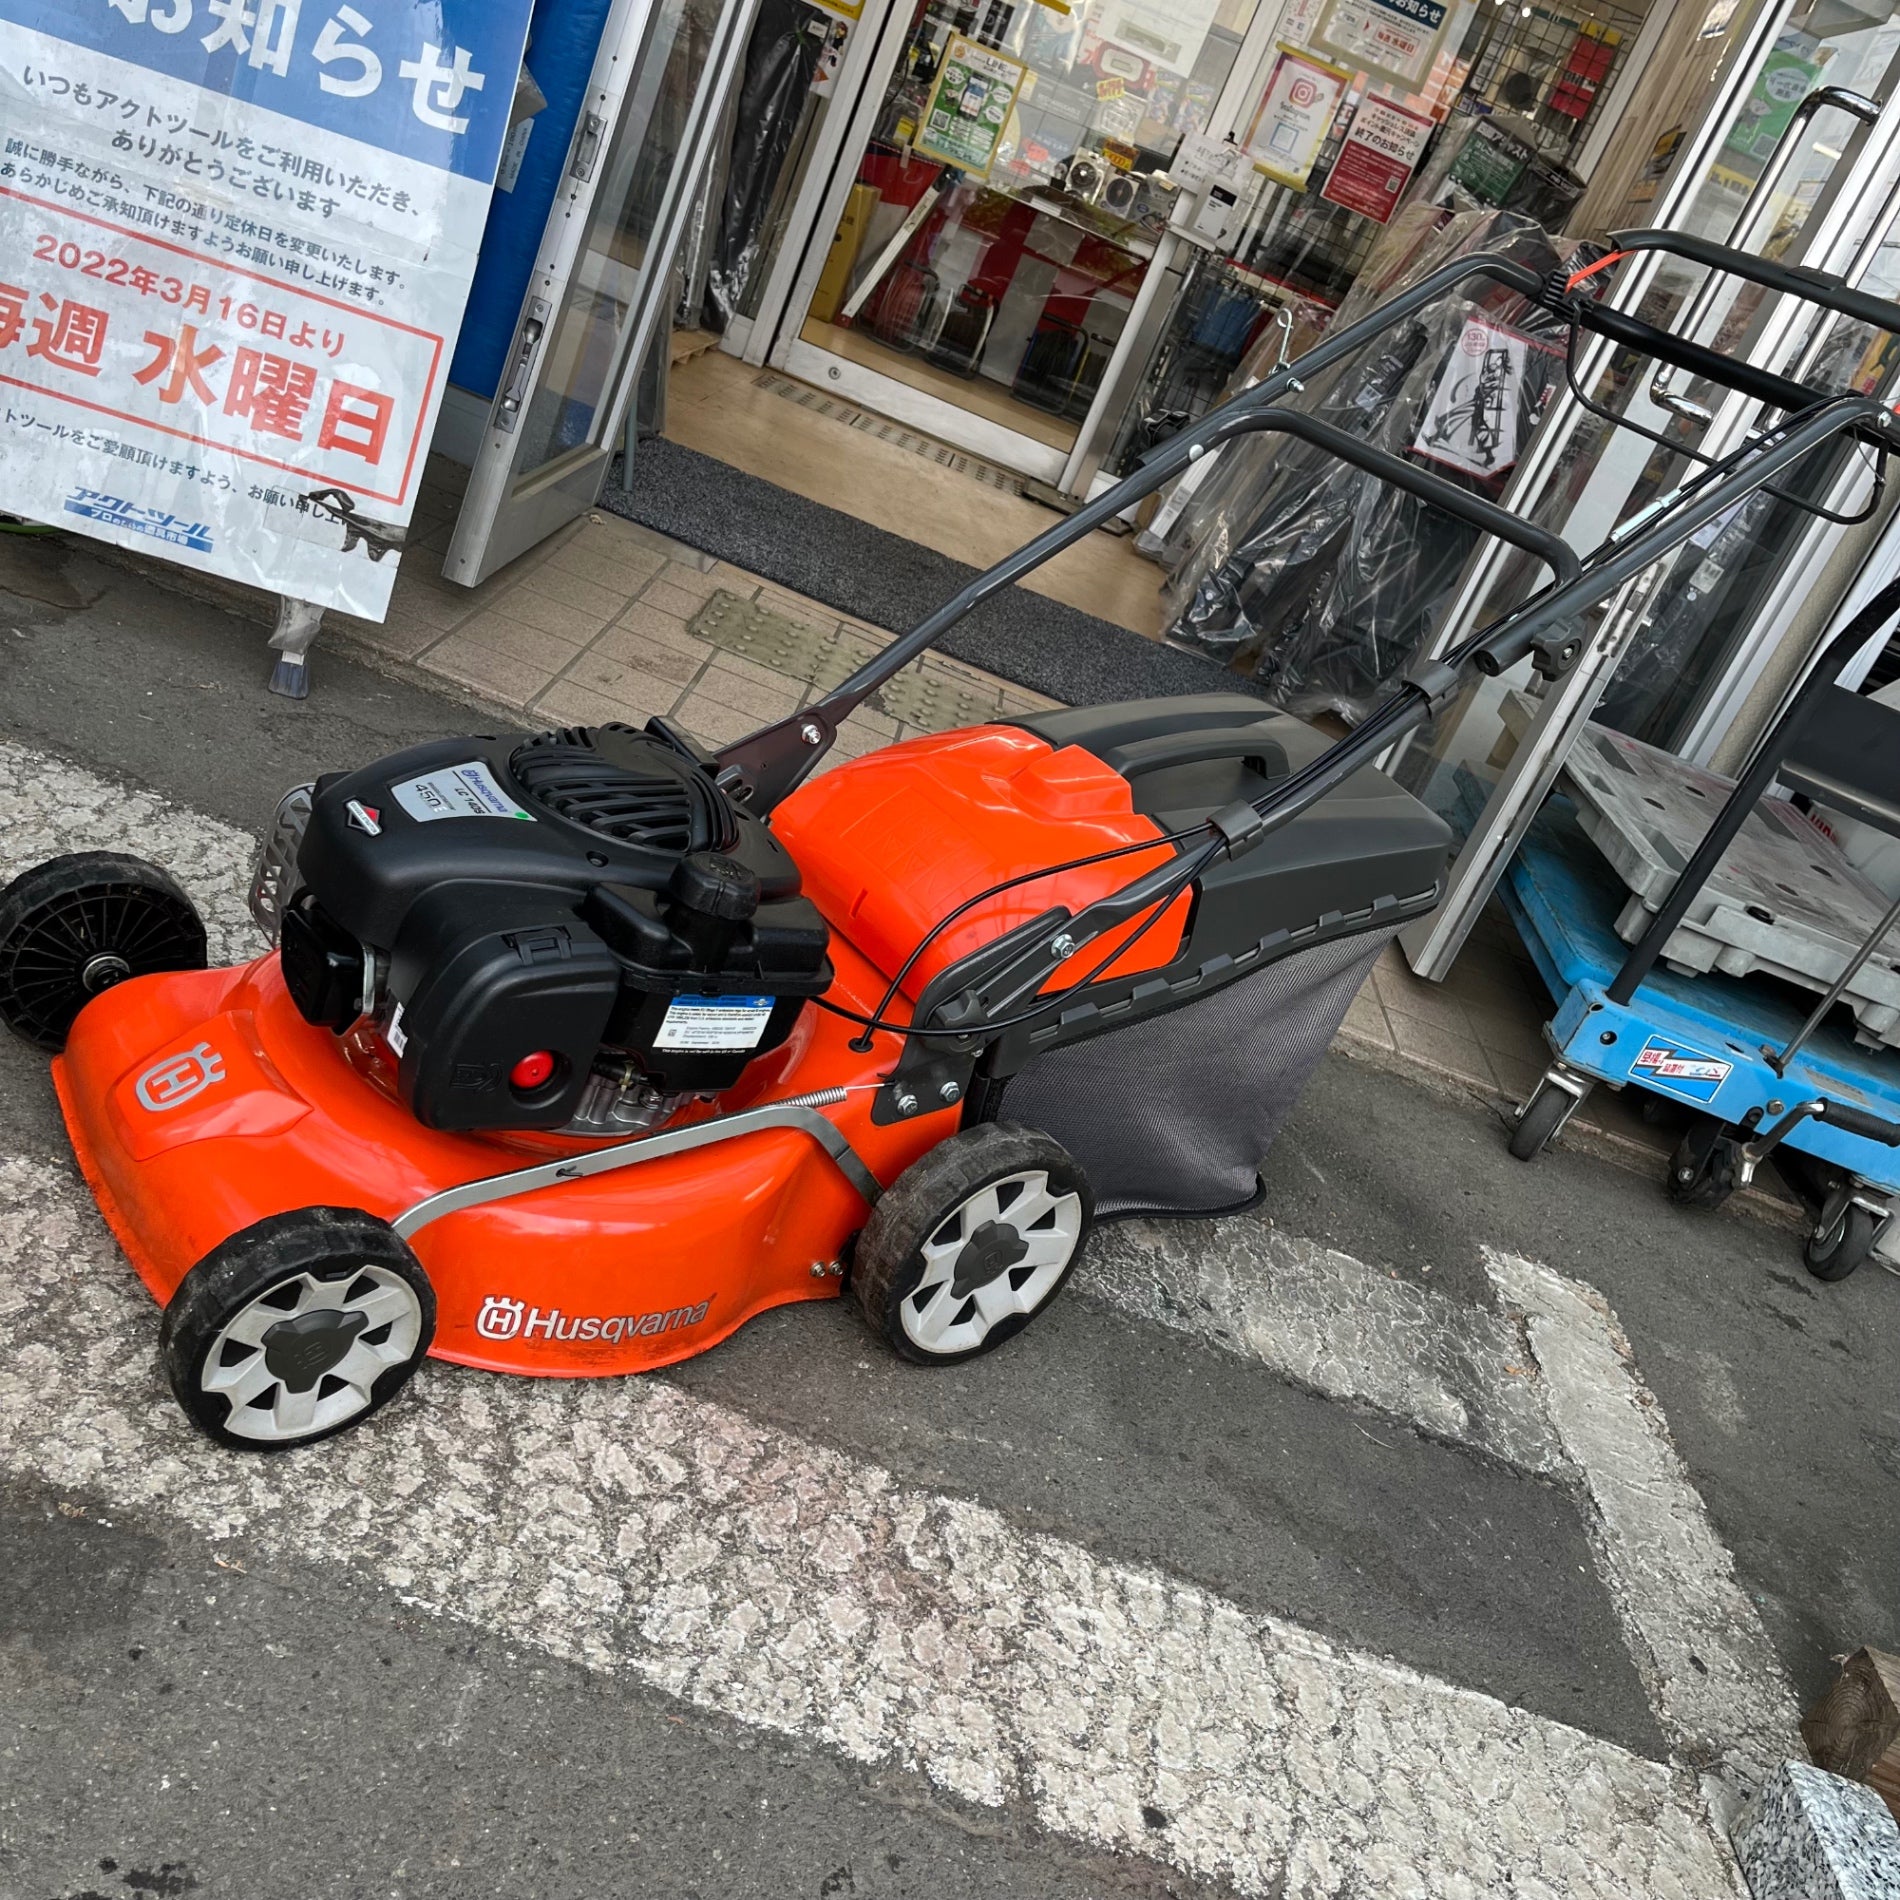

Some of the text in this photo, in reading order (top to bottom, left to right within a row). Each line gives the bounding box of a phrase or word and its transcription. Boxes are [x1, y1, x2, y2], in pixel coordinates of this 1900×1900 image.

[1390, 0, 1441, 24] お知らせ
[23, 65, 420, 216] いつもアクトツールをご利用いただき、
[111, 129, 341, 219] ありがとうございます
[1354, 126, 1415, 161] 終了のお知らせ
[0, 161, 385, 306] あらかじめご承知頂けますようお願い申し上げます。
[5, 137, 405, 290] 誠に勝手ながら、下記の通り定休日を変更いたします。
[32, 234, 346, 357] 2022年3月16日より
[133, 324, 396, 465] 水曜日
[66, 486, 215, 541] アクトツール
[454, 787, 469, 797] LC
[472, 775, 508, 813] Husqvarna
[523, 1299, 717, 1345] Husqvarna
